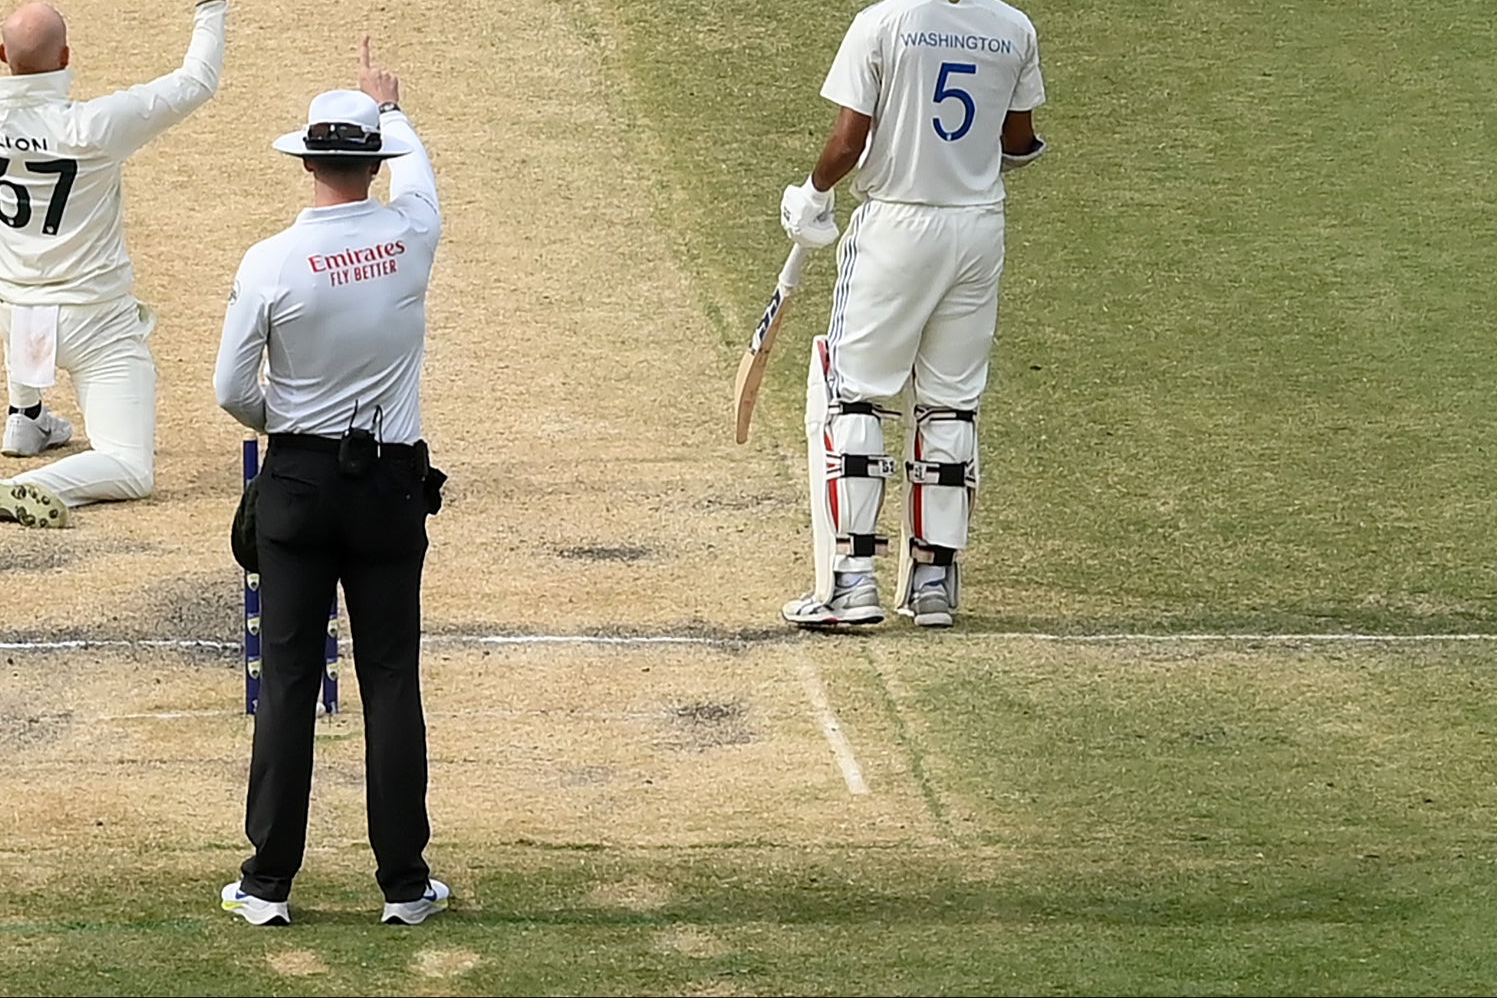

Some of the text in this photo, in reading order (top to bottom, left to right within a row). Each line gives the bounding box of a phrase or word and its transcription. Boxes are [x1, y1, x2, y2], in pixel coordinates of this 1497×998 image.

[901, 34, 1012, 54] WASHINGTON
[932, 62, 977, 141] 5
[308, 240, 406, 273] Emirates
[331, 259, 398, 287] FLY BETTER
